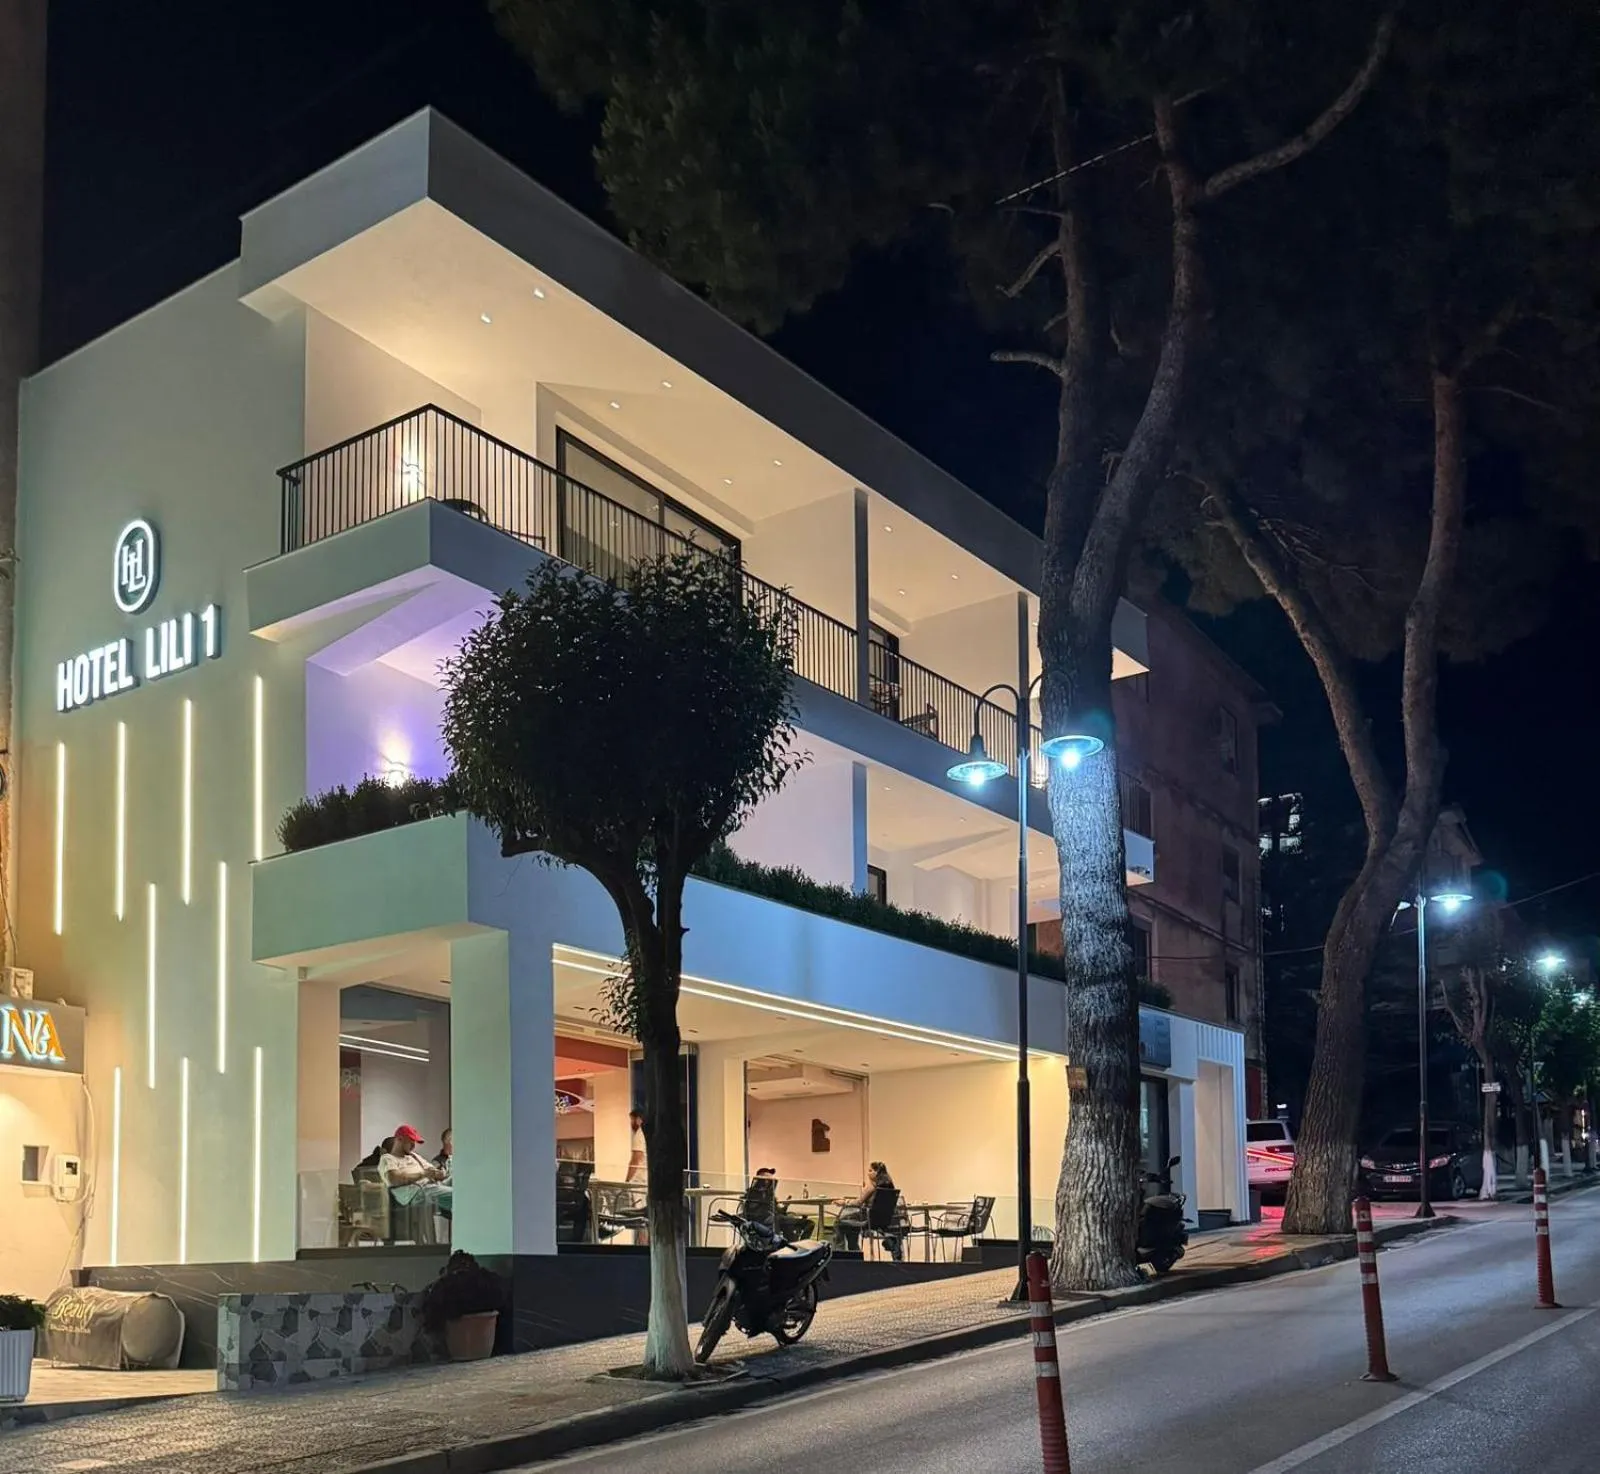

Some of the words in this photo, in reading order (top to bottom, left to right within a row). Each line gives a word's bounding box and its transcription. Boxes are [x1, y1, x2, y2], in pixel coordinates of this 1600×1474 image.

[57, 638, 134, 711] HOTEL
[146, 612, 193, 678] LILI
[201, 604, 216, 657] 1
